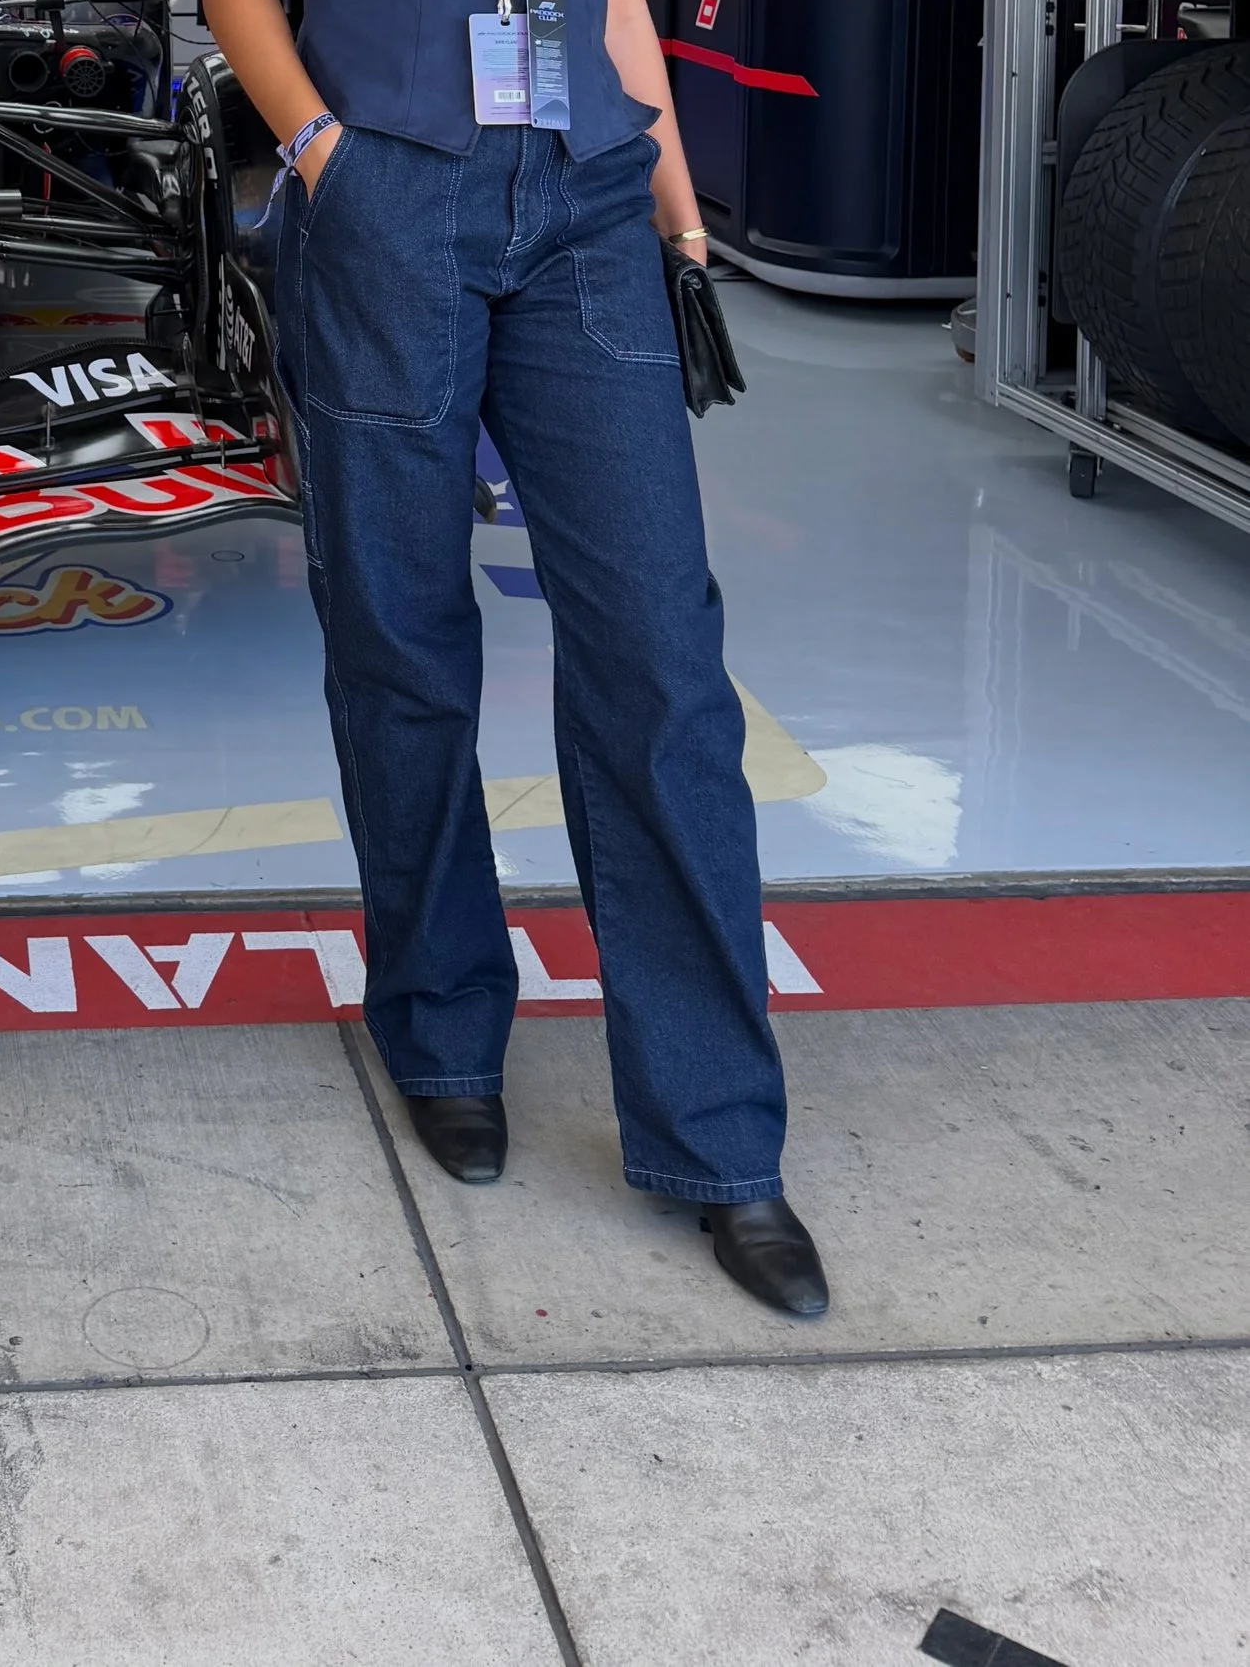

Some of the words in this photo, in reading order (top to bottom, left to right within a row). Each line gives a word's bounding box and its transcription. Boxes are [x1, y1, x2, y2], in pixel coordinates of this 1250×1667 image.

[187, 75, 219, 181] ZERO
[229, 310, 250, 375] AT&T
[9, 352, 177, 407] VISA
